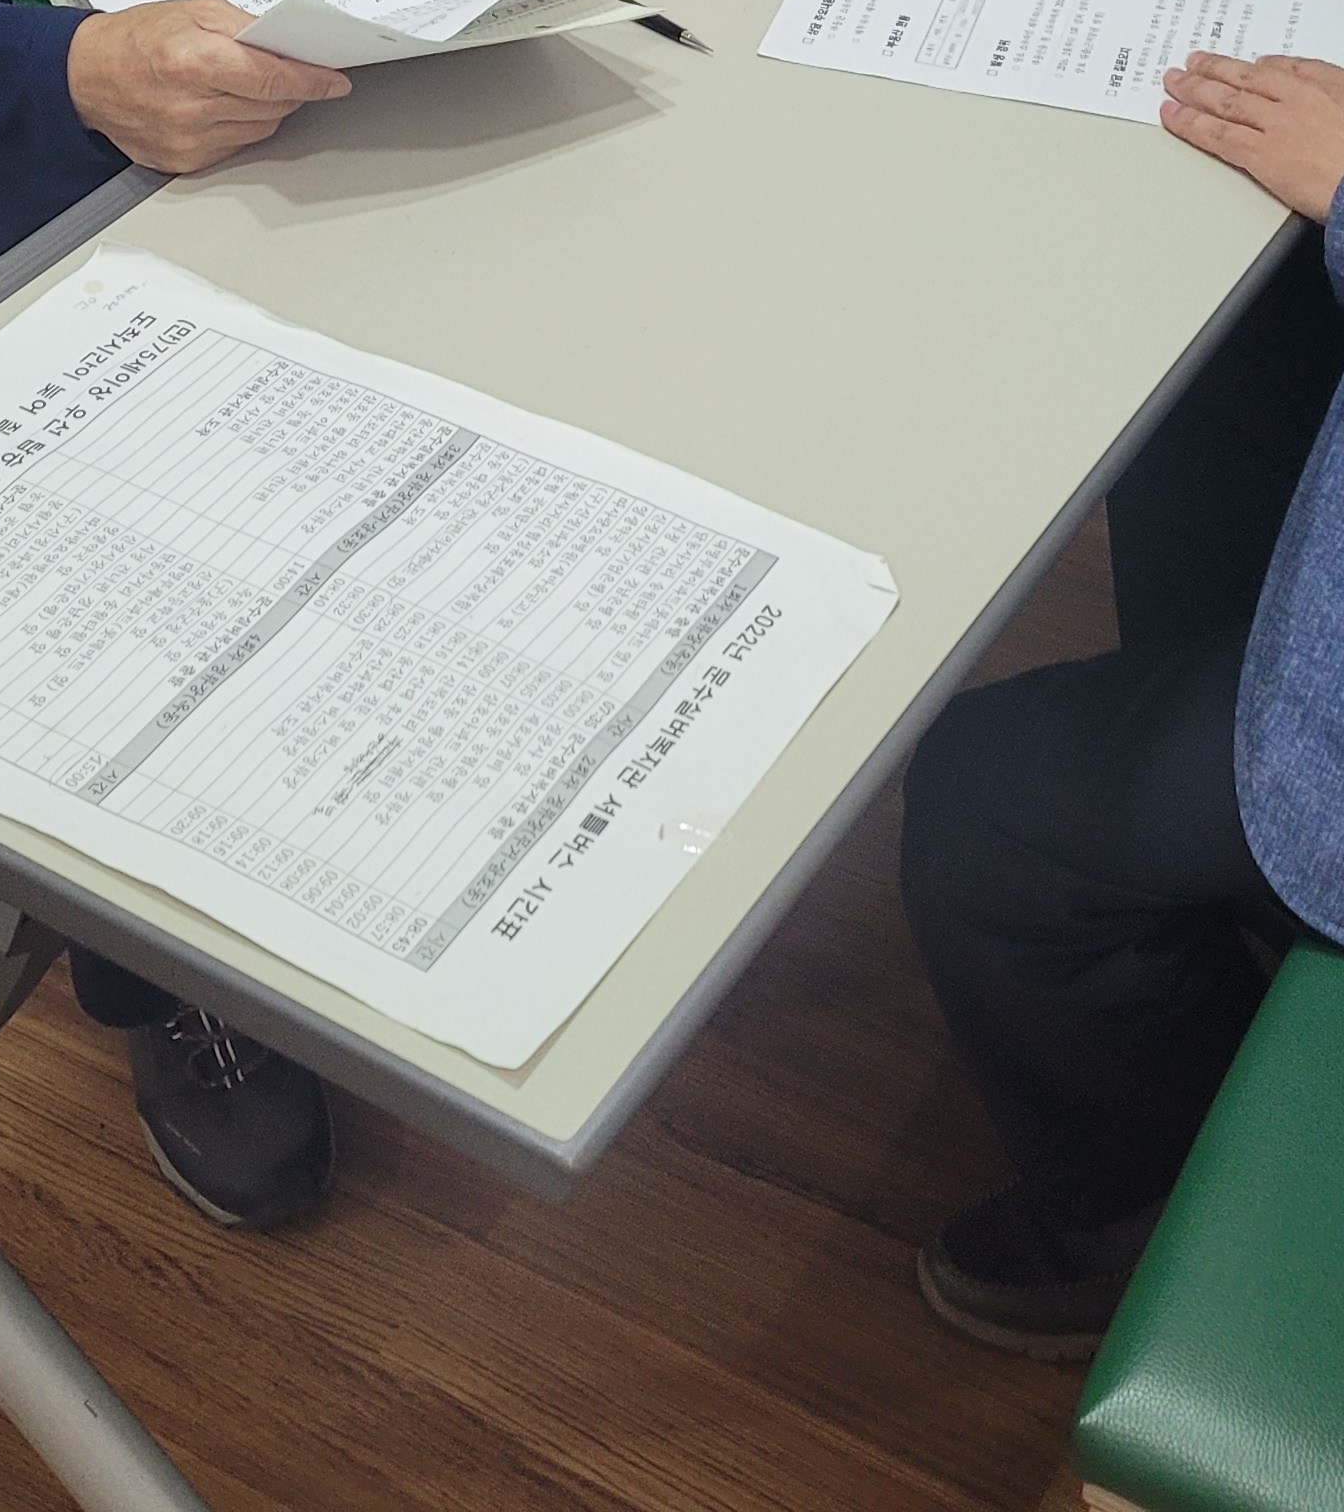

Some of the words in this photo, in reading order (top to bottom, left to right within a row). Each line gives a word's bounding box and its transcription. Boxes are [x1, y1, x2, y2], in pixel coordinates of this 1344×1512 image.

[60, 310, 161, 382] 도착시간이
[82, 317, 200, 403] (만)75세이상
[15, 381, 68, 416] 늦어
[39, 401, 93, 438] 우선
[290, 570, 326, 597] 시간
[721, 602, 784, 662] 2022년
[613, 664, 733, 790] 문수실버복지관
[85, 767, 123, 797] 시간
[166, 802, 209, 838] 09:20
[545, 790, 628, 873] 셔틀버스
[232, 834, 274, 871] 09:14
[254, 845, 296, 882] 09:12
[320, 880, 363, 918] 09:04
[342, 892, 385, 931] 09:02
[487, 874, 558, 943] 시간표
[366, 904, 408, 943] 08:57
[388, 915, 430, 954] 08:45
